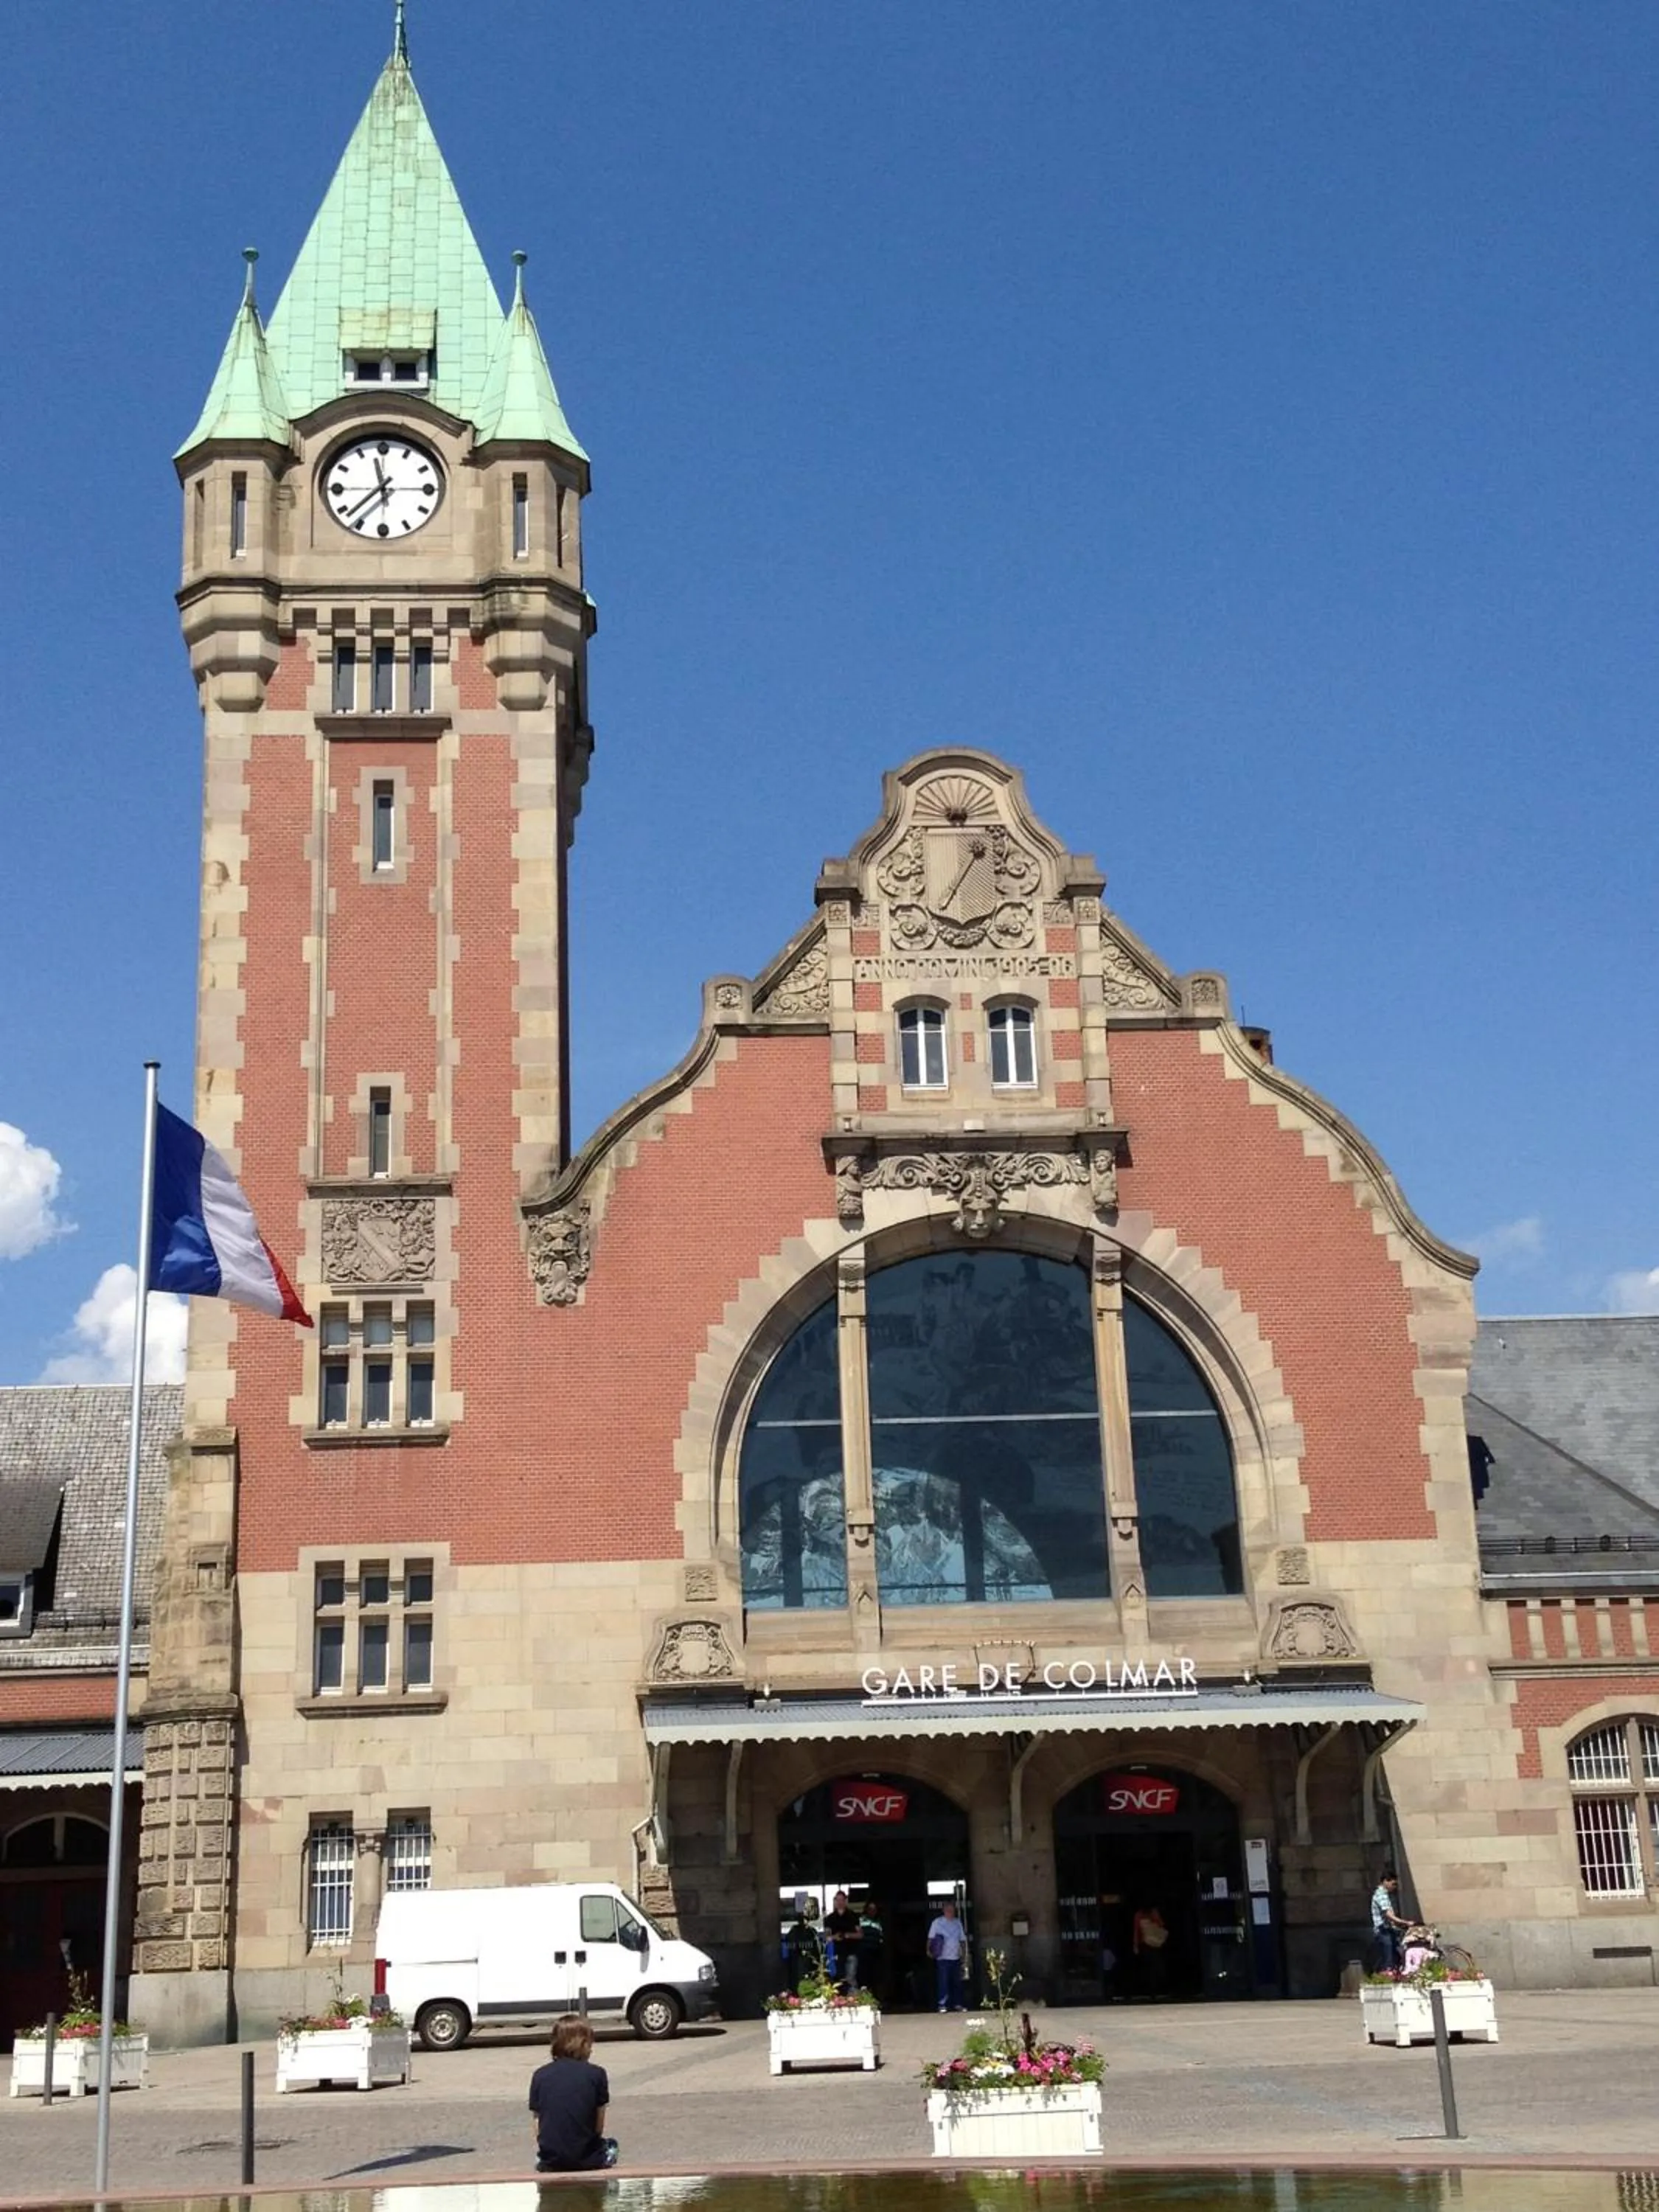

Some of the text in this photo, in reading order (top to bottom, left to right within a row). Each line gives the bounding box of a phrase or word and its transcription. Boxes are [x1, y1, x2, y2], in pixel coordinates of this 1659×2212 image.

[854, 958, 910, 979] ANNO
[861, 1657, 1197, 1694] GARE DE COLMAR
[835, 1795, 903, 1818] SNCF
[1109, 1788, 1175, 1810] SNCF
